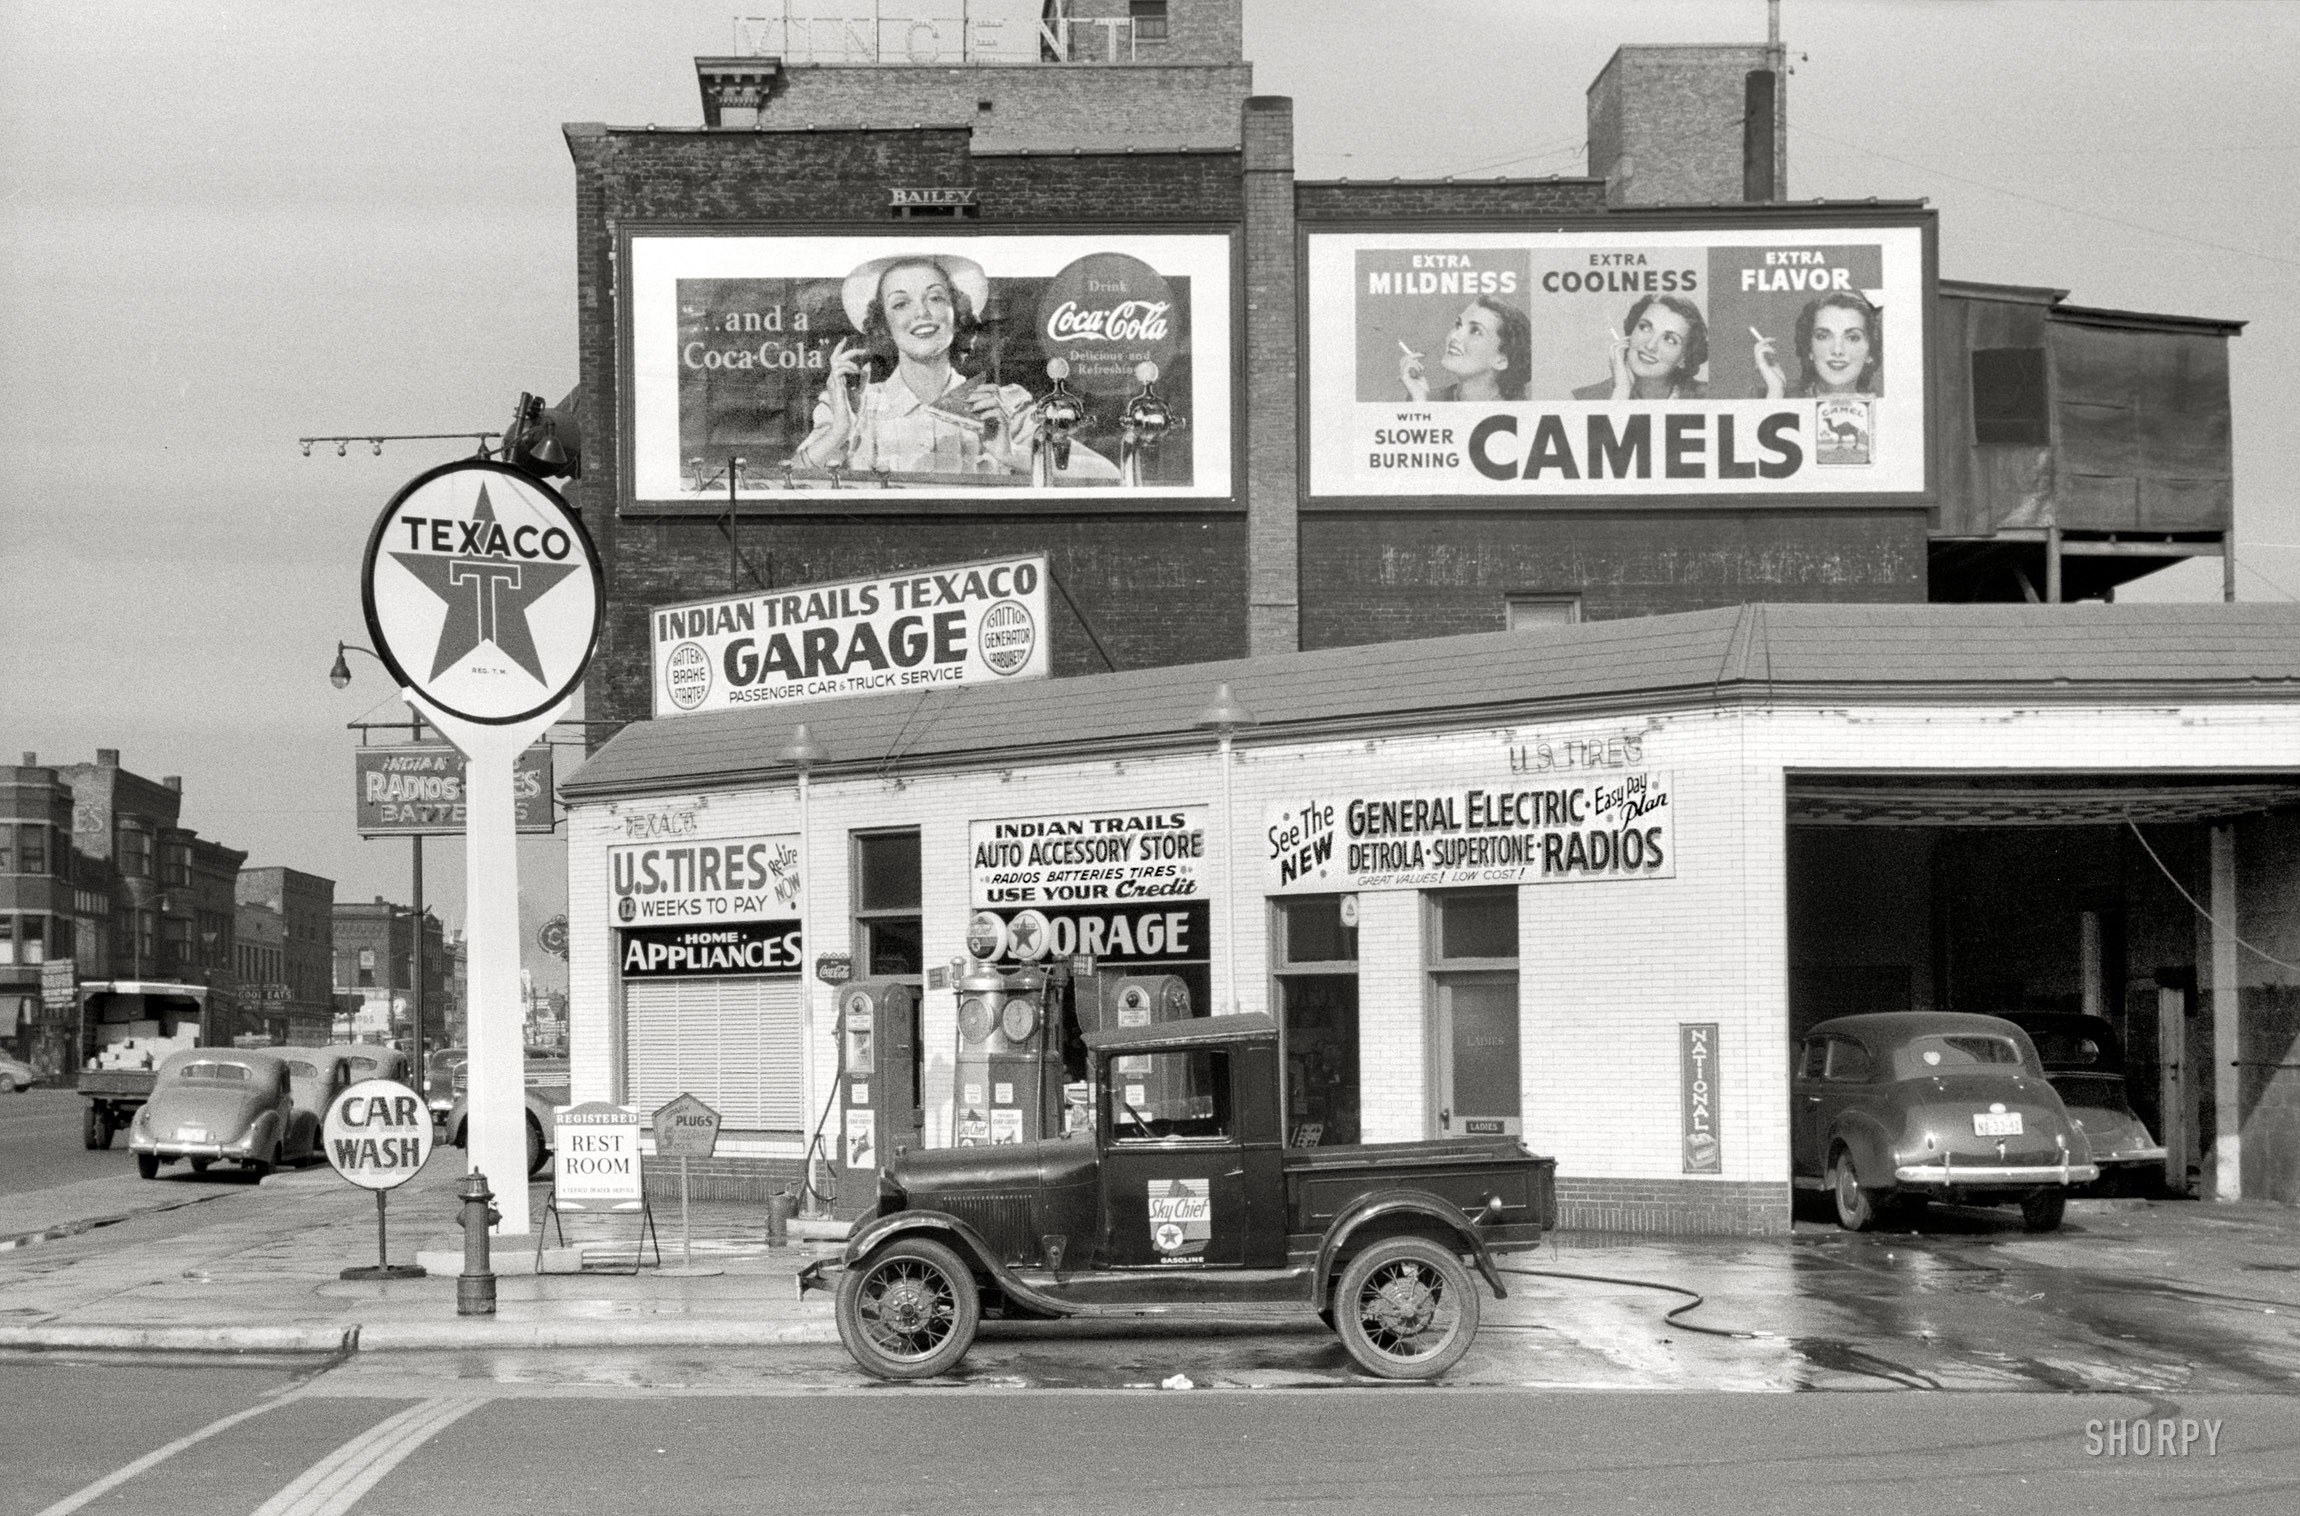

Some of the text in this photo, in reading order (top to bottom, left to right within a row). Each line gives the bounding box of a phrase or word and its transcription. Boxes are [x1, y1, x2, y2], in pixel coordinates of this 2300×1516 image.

[891, 190, 972, 205] BAILEY
[1412, 254, 1471, 268] EXTRA
[1589, 253, 1647, 266] EXTRA
[1765, 251, 1825, 265] EXTRA
[1089, 280, 1127, 292] Drink
[1369, 271, 1517, 294] MILDNESS
[1542, 270, 1697, 292] COOLNESS
[1741, 268, 1851, 291] FLAVOR
[794, 311, 809, 331] a
[1047, 301, 1171, 341] Coca-Cola
[1070, 350, 1151, 361] Delicious and
[1397, 413, 1431, 421] WITH
[1822, 405, 1864, 418] CAMEL
[1374, 429, 1454, 445] SLOWER
[1468, 412, 1803, 481] CAMELS
[1369, 453, 1460, 468] BURNING
[401, 516, 571, 561] TEXACO
[658, 563, 1038, 642] INDIAN TRAILS TEXACO
[987, 606, 1026, 628] IGNITION
[723, 609, 968, 687] GARAGE
[984, 628, 1031, 649] GENERATOR
[672, 648, 704, 666] BATTERY
[673, 667, 706, 684] BRAKE
[729, 666, 963, 703] PASSENGER CAR & TRUCK SERVICE
[674, 685, 706, 704] STARTER
[382, 755, 447, 771] INDIAN
[366, 771, 459, 802] RADIOS
[1595, 773, 1648, 815] Easy Pay
[1347, 788, 1585, 839] GENERAL ELECTRIC
[1620, 793, 1668, 833] Plan
[624, 812, 697, 838] TEXACO
[996, 813, 1185, 839] INDIAN TRAILS
[1268, 800, 1334, 860] See The
[975, 829, 1203, 869] AUTO ACCESSORY STORE
[1281, 831, 1334, 887] NEW
[1348, 826, 1664, 875] DETROLA SUPERTONE RADIOS
[614, 843, 768, 896] U.S. TIRES
[991, 865, 1176, 884] RADIOS BATTERIES TIRES
[1357, 875, 1394, 886] GREAT
[1452, 870, 1478, 882] LOW
[774, 872, 801, 903] NOW
[987, 878, 1198, 902] USE YOUR Credit
[641, 899, 701, 917] WEEKS
[706, 897, 728, 914] TO
[734, 895, 768, 914] PAY
[685, 932, 738, 944] HOME
[624, 931, 802, 971] APPLIANCES
[267, 990, 292, 1000] EATS
[1691, 1029, 1709, 1131] NATIONAL
[340, 1096, 419, 1128] CAR
[556, 1113, 637, 1124] REGISTERED
[676, 1115, 713, 1127] PLUGS
[1470, 1122, 1498, 1131] LADIES
[333, 1138, 420, 1169] WASH
[572, 1135, 625, 1151] REST
[566, 1158, 630, 1174] ROOM
[1149, 1198, 1209, 1223] Sky Chief
